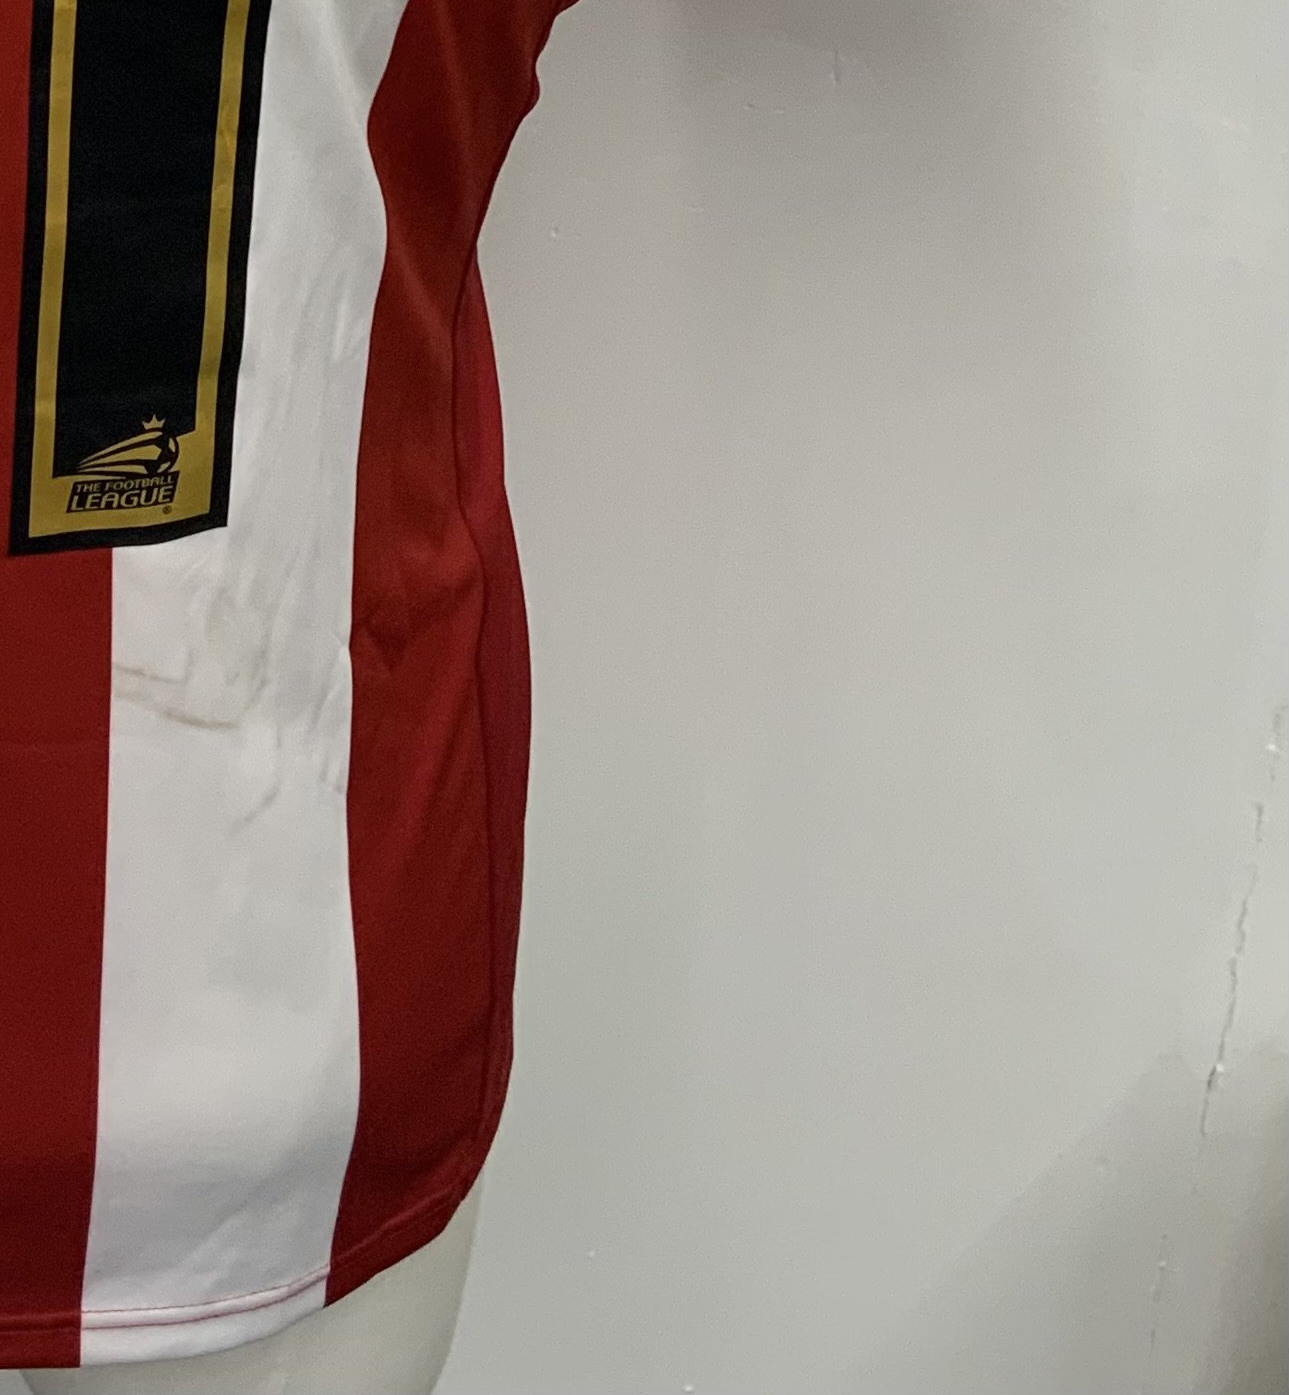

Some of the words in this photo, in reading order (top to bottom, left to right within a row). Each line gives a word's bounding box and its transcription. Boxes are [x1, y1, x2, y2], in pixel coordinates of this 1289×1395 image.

[76, 481, 101, 493] THE
[103, 474, 175, 493] FOOTBALL
[69, 485, 174, 511] LEAGUE
